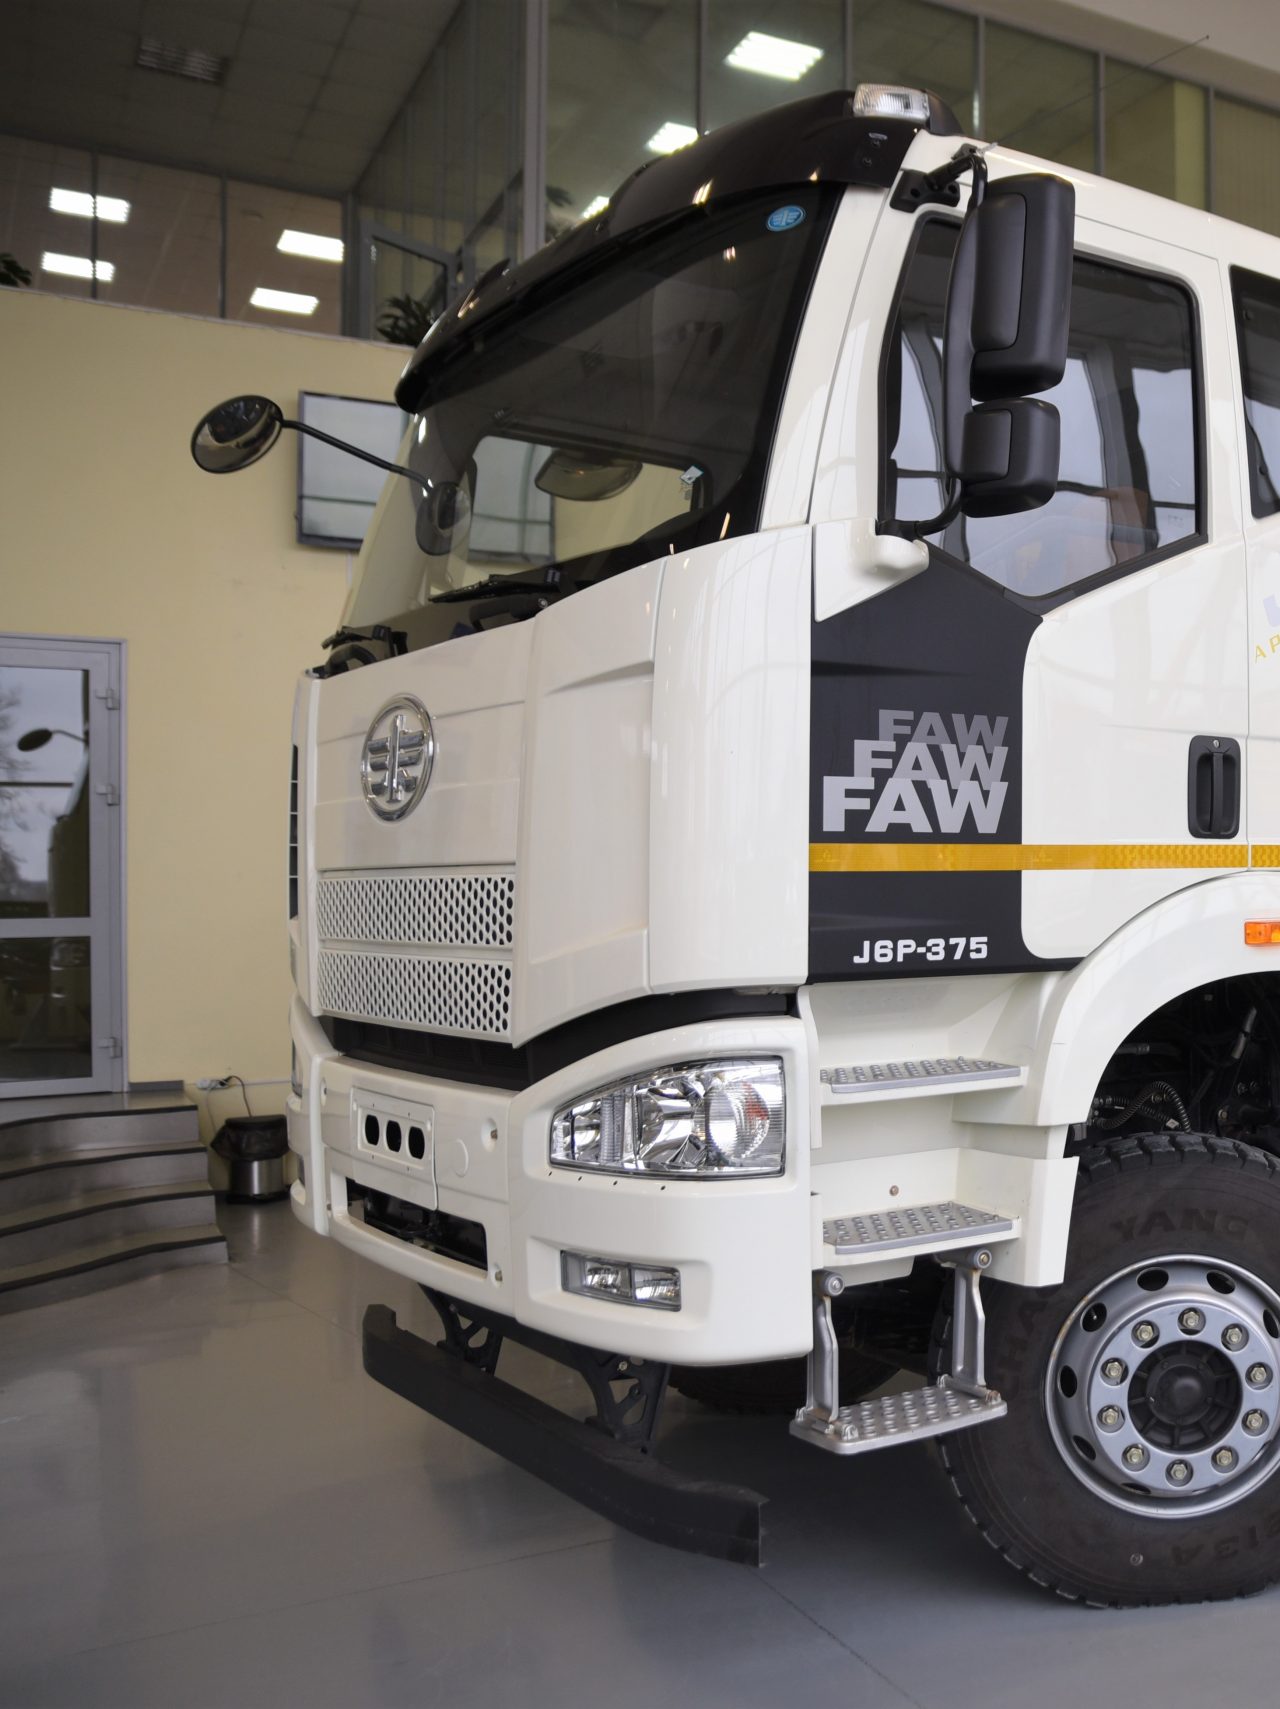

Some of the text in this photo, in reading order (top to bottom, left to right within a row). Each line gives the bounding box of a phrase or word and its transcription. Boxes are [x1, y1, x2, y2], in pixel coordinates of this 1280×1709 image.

[1254, 645, 1267, 664] A
[878, 709, 1008, 754] FAW
[853, 739, 1008, 790] FAW
[822, 775, 1008, 834] FAW
[853, 936, 988, 964] J6P-375
